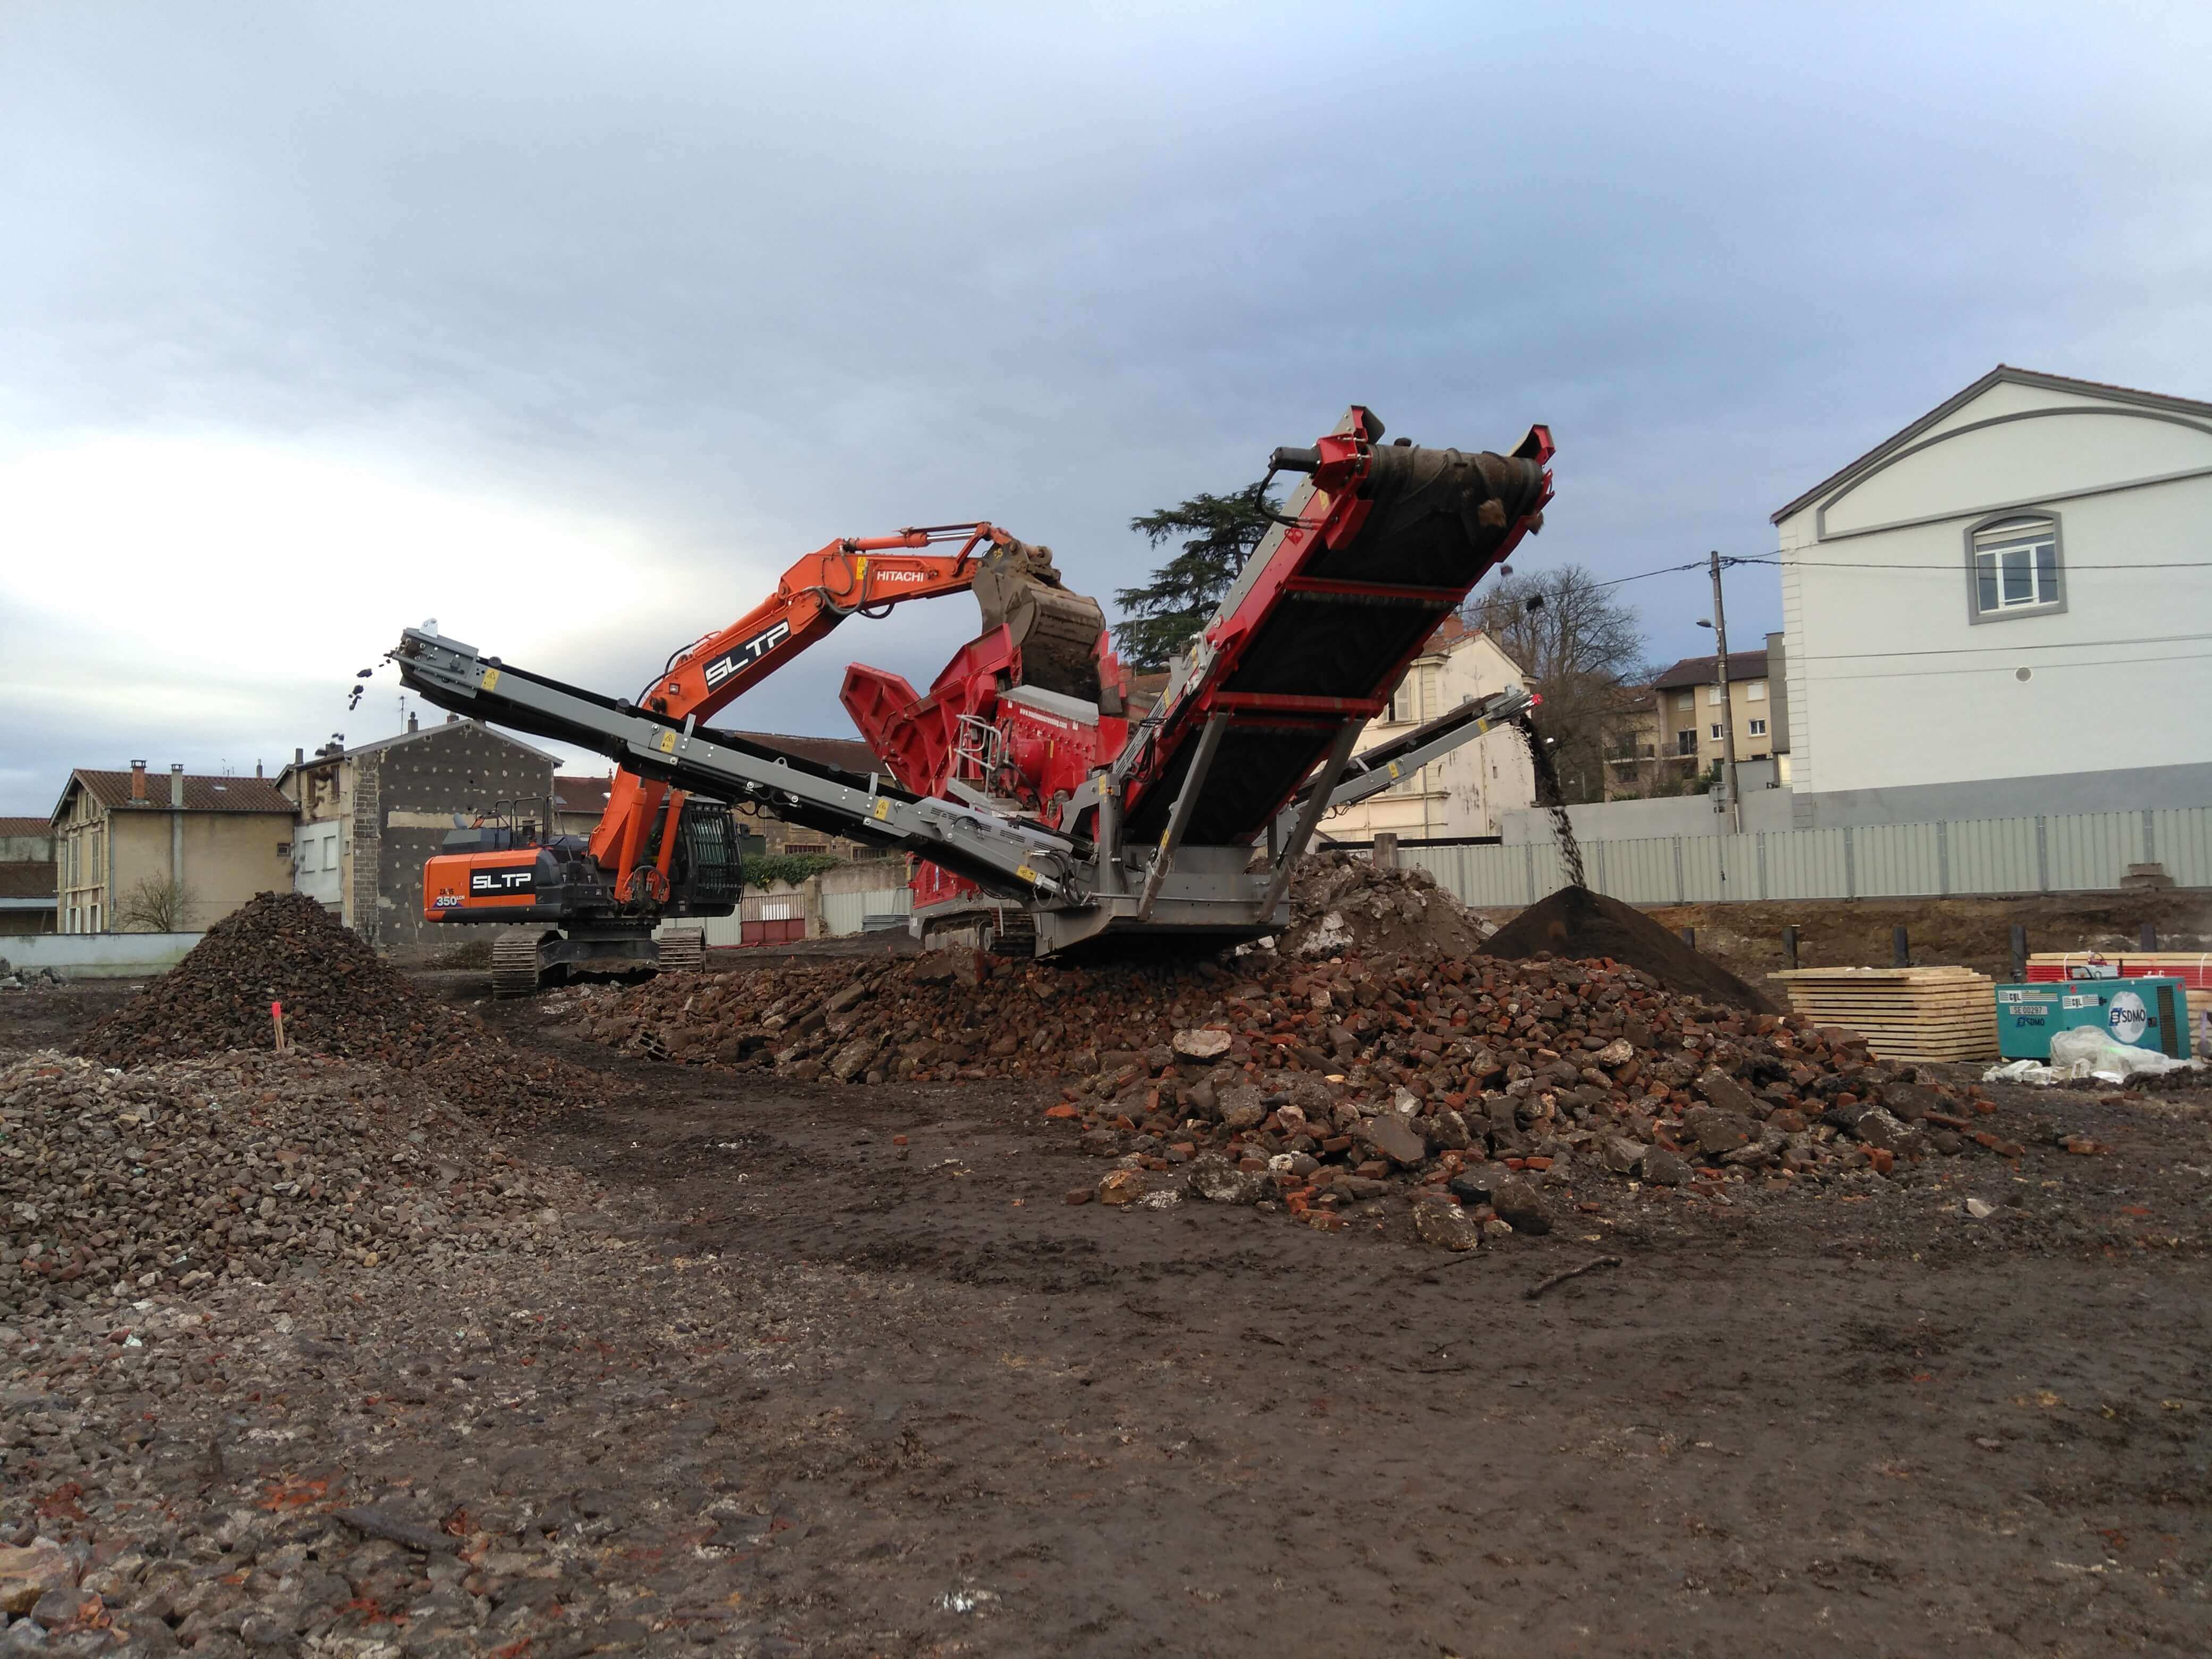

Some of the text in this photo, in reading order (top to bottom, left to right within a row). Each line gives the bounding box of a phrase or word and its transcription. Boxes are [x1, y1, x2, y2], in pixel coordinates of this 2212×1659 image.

[876, 571, 924, 582] HITACHI
[705, 621, 790, 686] SLTP
[473, 873, 532, 889] SLTP
[436, 896, 457, 907] 350
[2122, 1009, 2146, 1023] SDMO
